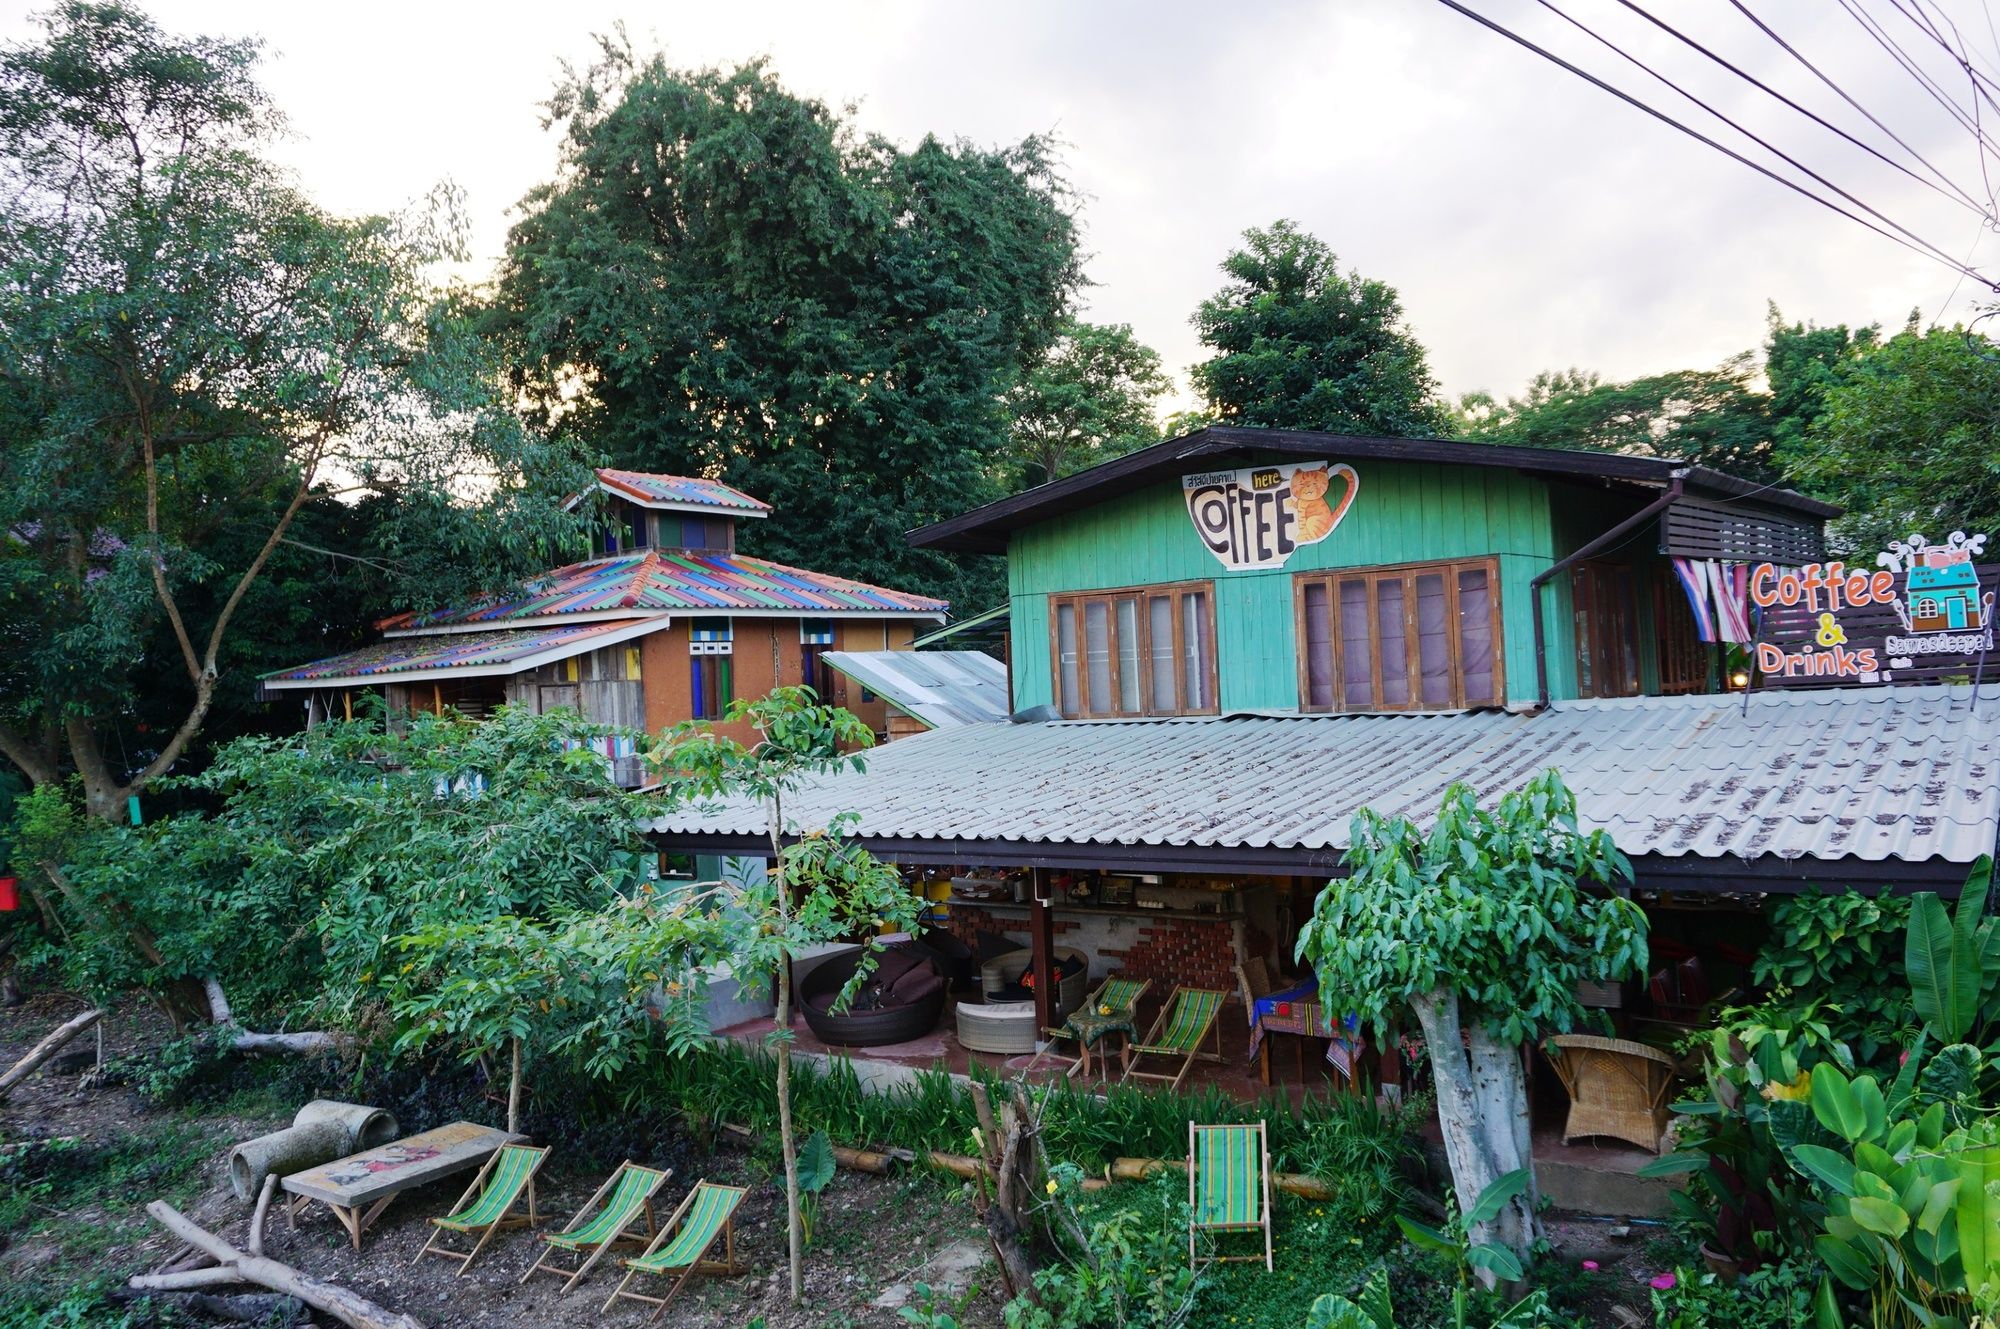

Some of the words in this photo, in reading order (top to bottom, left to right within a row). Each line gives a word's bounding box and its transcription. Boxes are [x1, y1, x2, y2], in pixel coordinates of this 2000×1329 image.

[1254, 471, 1281, 488] here
[1190, 483, 1296, 564] COFFEE
[1751, 562, 1897, 613] Coffee
[1816, 613, 1848, 647] &
[1758, 643, 1879, 677] Drinks
